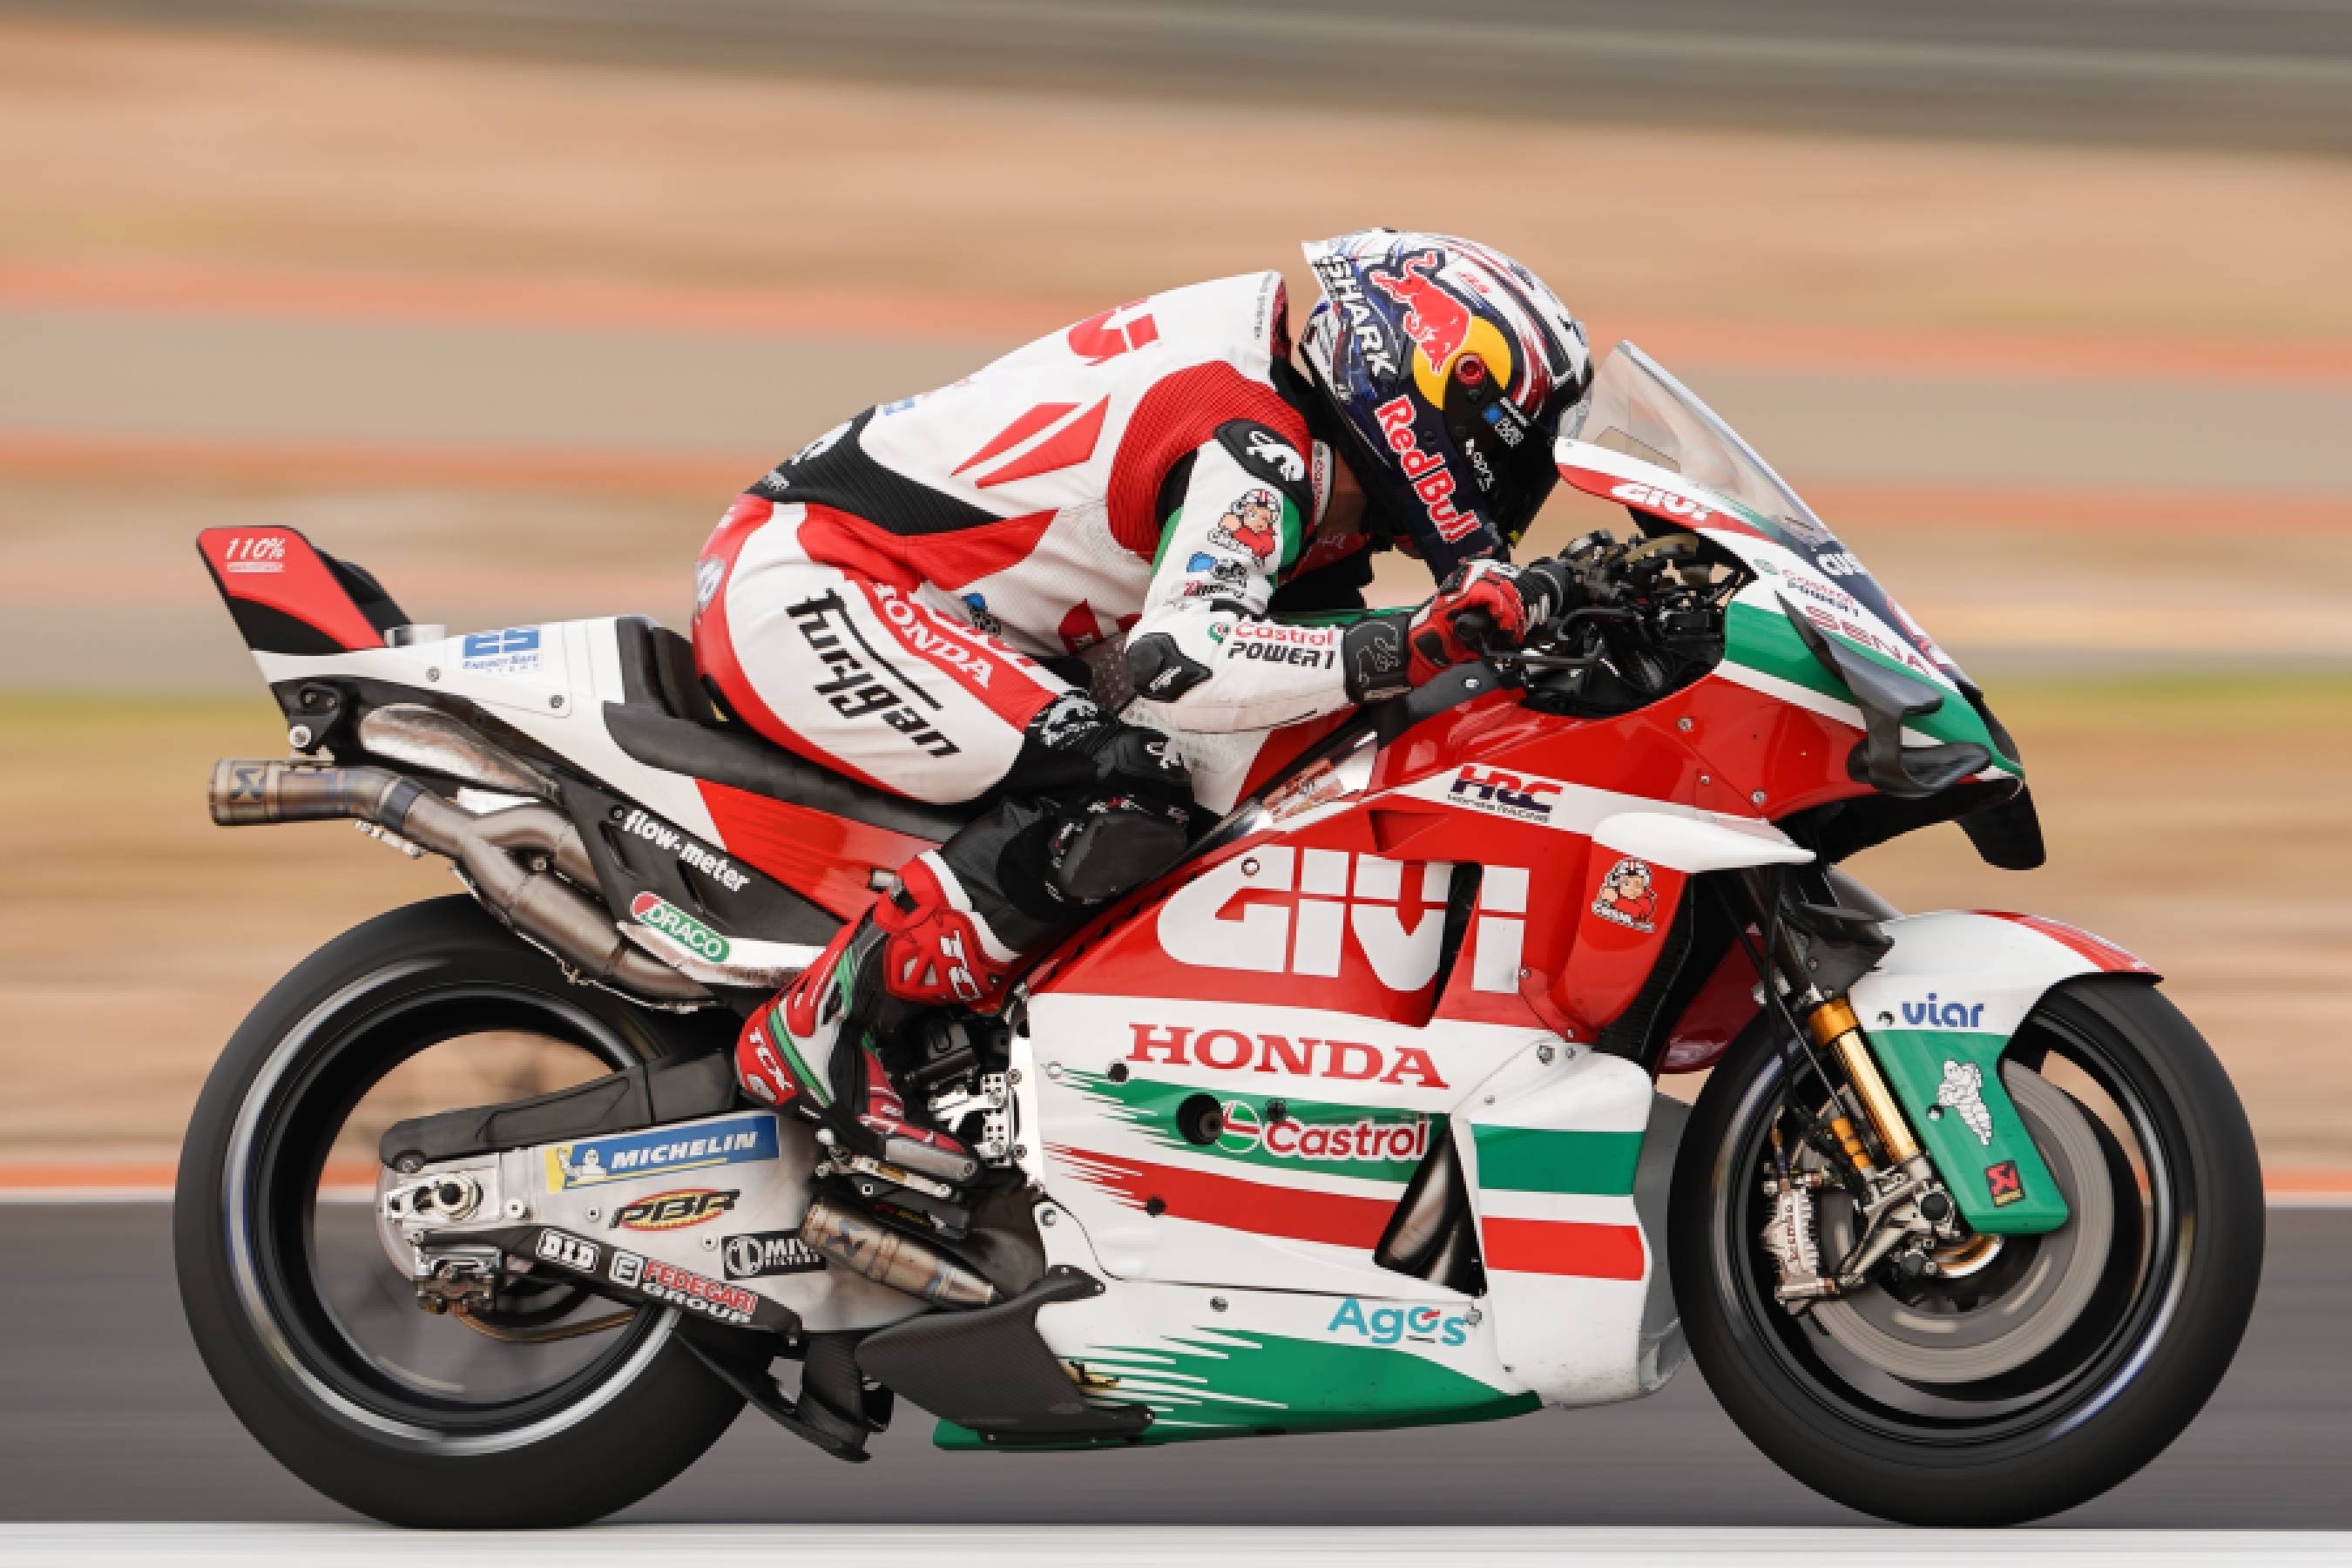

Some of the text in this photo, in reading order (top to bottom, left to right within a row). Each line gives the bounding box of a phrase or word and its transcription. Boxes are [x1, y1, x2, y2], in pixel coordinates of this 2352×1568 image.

[1313, 253, 1398, 377] SHARK
[1375, 395, 1446, 481] Red
[1413, 468, 1482, 544] Bull
[225, 537, 286, 559] 110%
[1227, 639, 1336, 670] POWER1
[1235, 619, 1335, 646] Castrol
[1450, 765, 1564, 813] HRC
[624, 809, 751, 893] flow-meter
[647, 902, 722, 958] DRACO
[1157, 843, 1530, 994] GIVI
[1902, 992, 1984, 1028] viar
[1125, 1022, 1450, 1089] HONDA
[612, 1132, 758, 1169] MICHELIN
[1266, 1119, 1429, 1159] Castrol
[642, 1281, 753, 1325] GROUP
[644, 1260, 757, 1315] FEDEGARI
